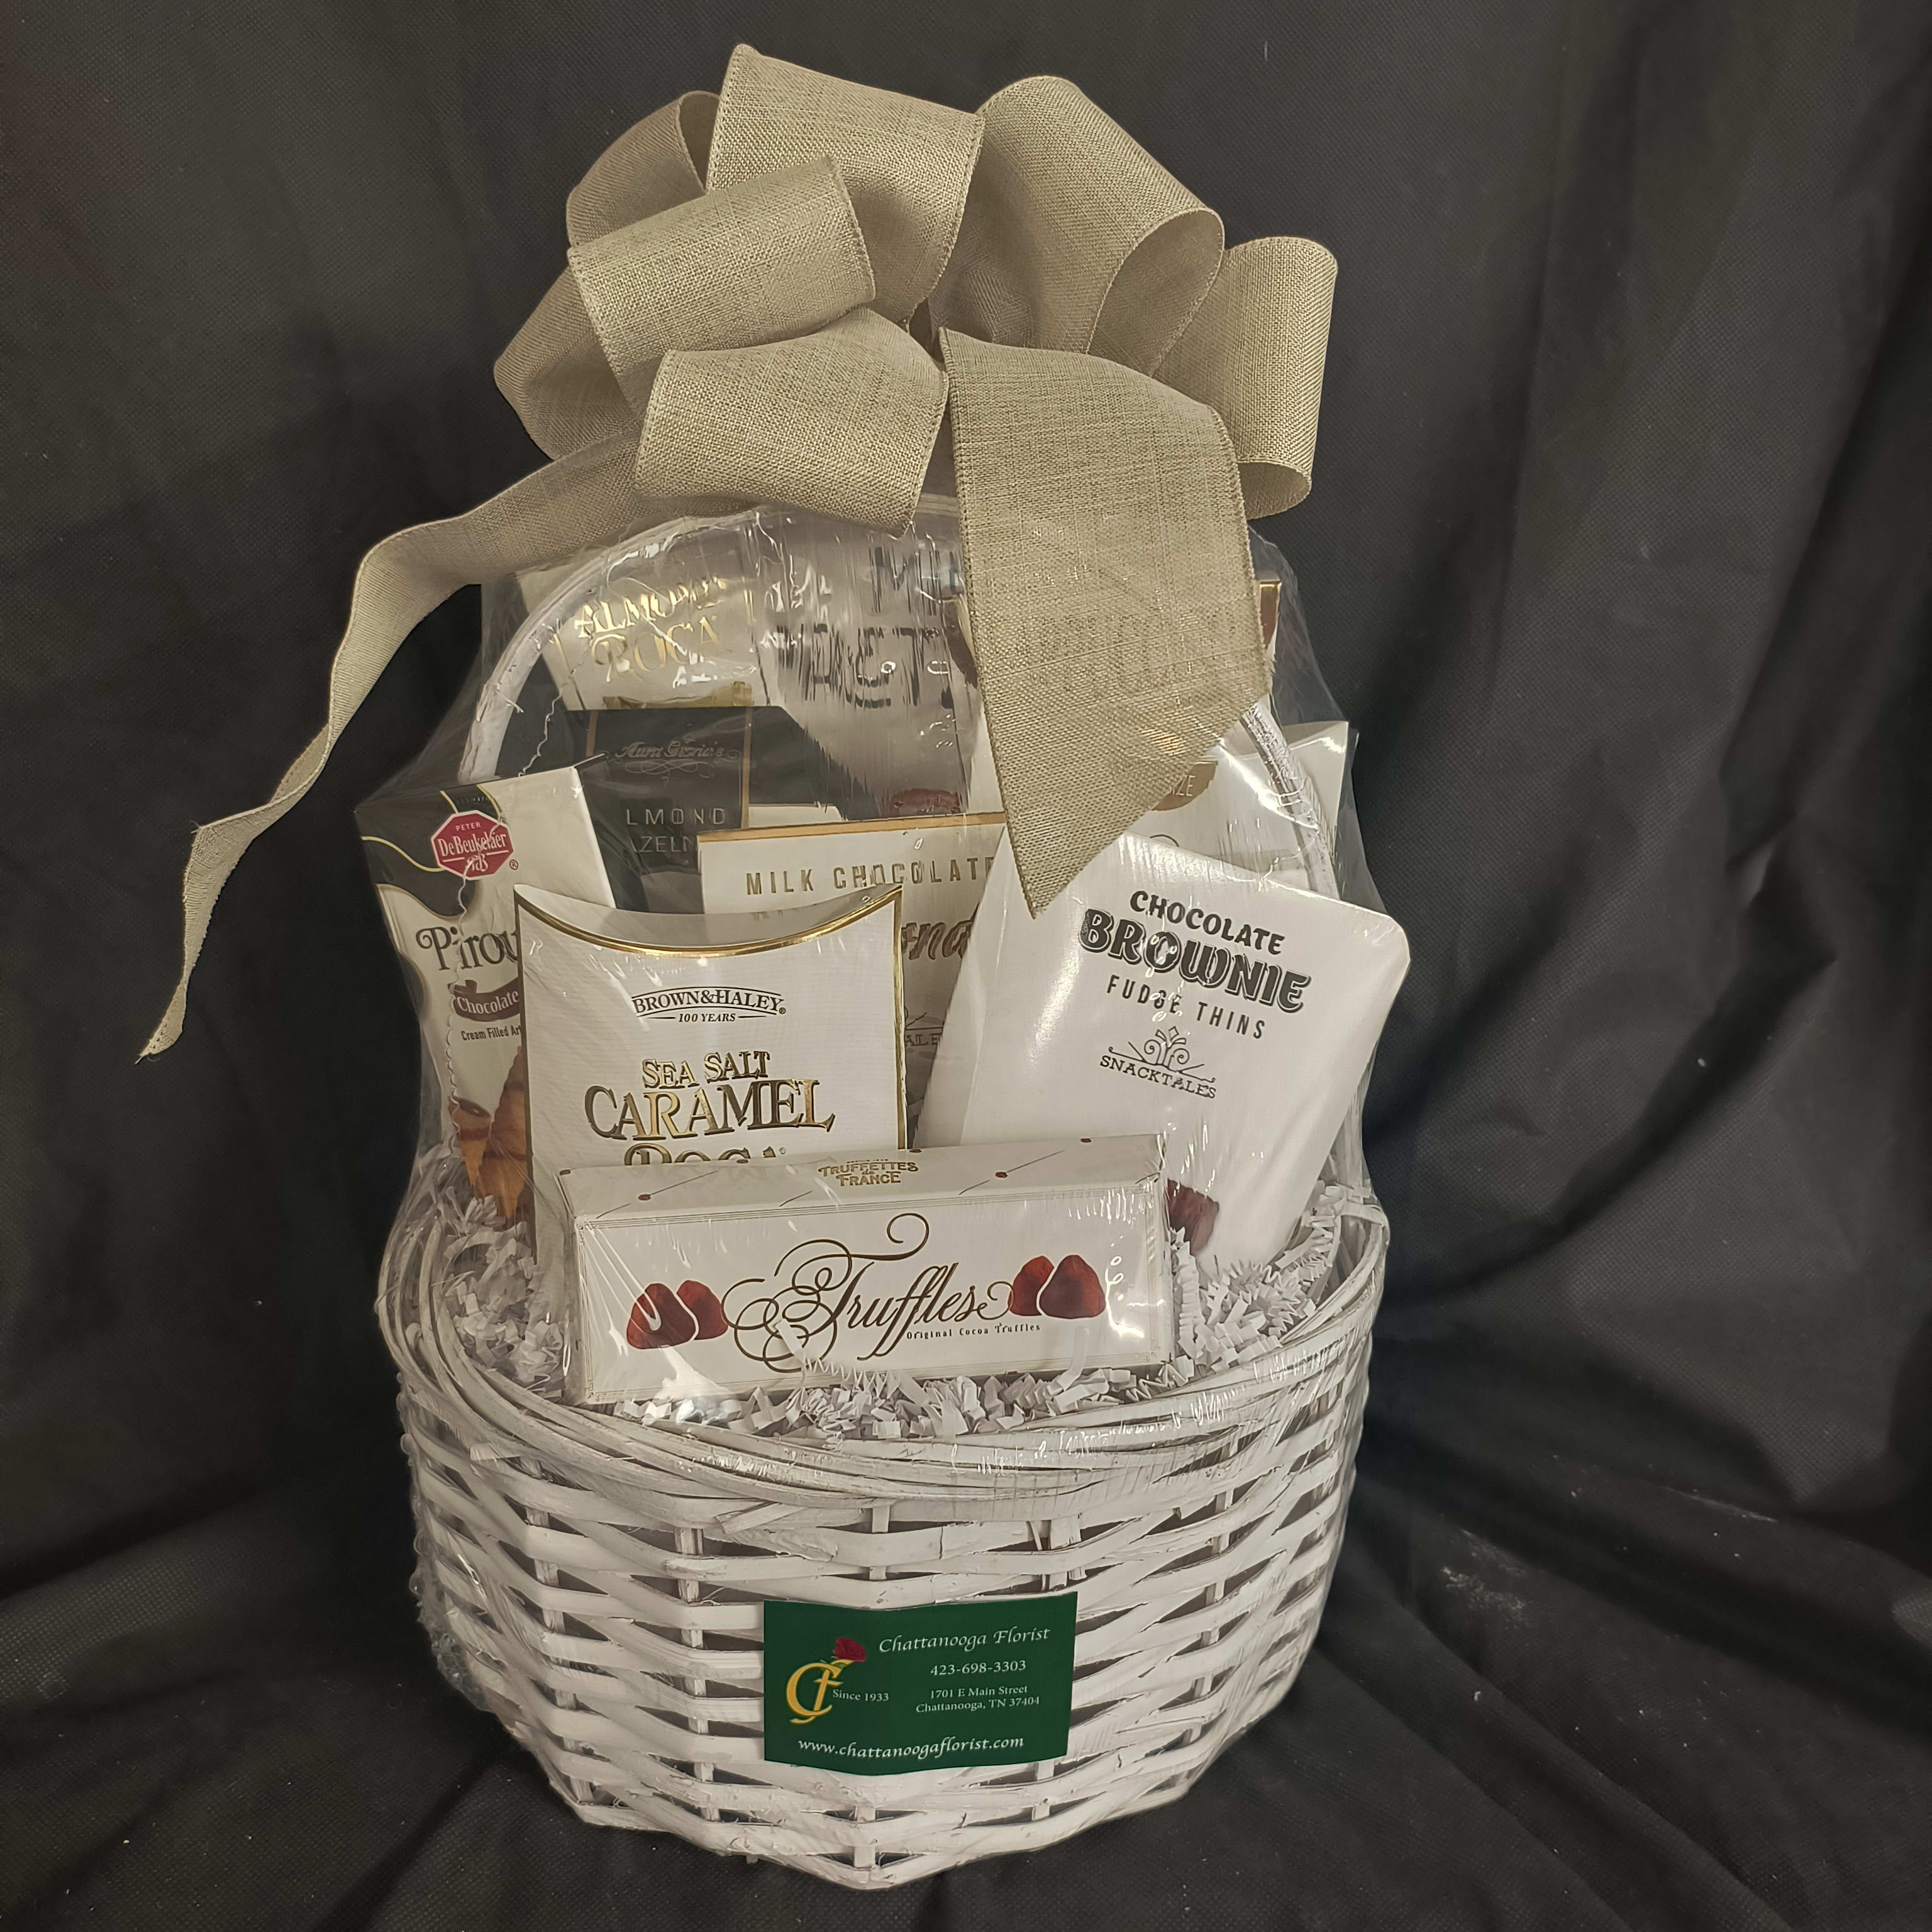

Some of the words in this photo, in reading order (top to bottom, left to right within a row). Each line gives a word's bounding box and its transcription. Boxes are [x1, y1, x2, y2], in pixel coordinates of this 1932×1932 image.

[455, 821, 481, 831] PETER
[747, 869, 814, 895] MILK
[1130, 891, 1285, 955] CHOCOLATE
[1078, 908, 1311, 1013] BROWNIE
[457, 991, 519, 1014] Chocolate
[1106, 975, 1182, 1014] FUDGE
[1197, 1002, 1265, 1039] THINS
[679, 1013, 698, 1022] 100
[701, 1013, 736, 1022] YEARS
[461, 1030, 486, 1041] Cream
[487, 1025, 509, 1038] Filled
[642, 1058, 699, 1089] SEA
[704, 1051, 770, 1082] SALT
[1099, 1055, 1216, 1099] SNACKTALES
[584, 1078, 836, 1140] CARAMEL
[818, 1162, 919, 1177] TRUFFETTES
[835, 1170, 901, 1187] FRANCE
[736, 1213, 1014, 1365] Truffles
[906, 1328, 952, 1340] Original
[959, 1328, 989, 1336] Cocoa
[994, 1322, 1041, 1333] Truffles
[879, 1635, 987, 1653] Chattanooga
[992, 1626, 1052, 1644] Florist
[930, 1659, 1027, 1677] 423-698-3303
[833, 1689, 862, 1701] Since
[865, 1692, 889, 1702] 1933
[930, 1689, 954, 1699] 1701
[958, 1688, 965, 1697] E
[968, 1686, 996, 1696] Main
[998, 1685, 1028, 1696] Street
[916, 1701, 986, 1713] Chattanooga,
[989, 1698, 1007, 1709] TN
[1009, 1696, 1040, 1707] 37404
[797, 1735, 1024, 1760] www.chattanoogaflorist.com
